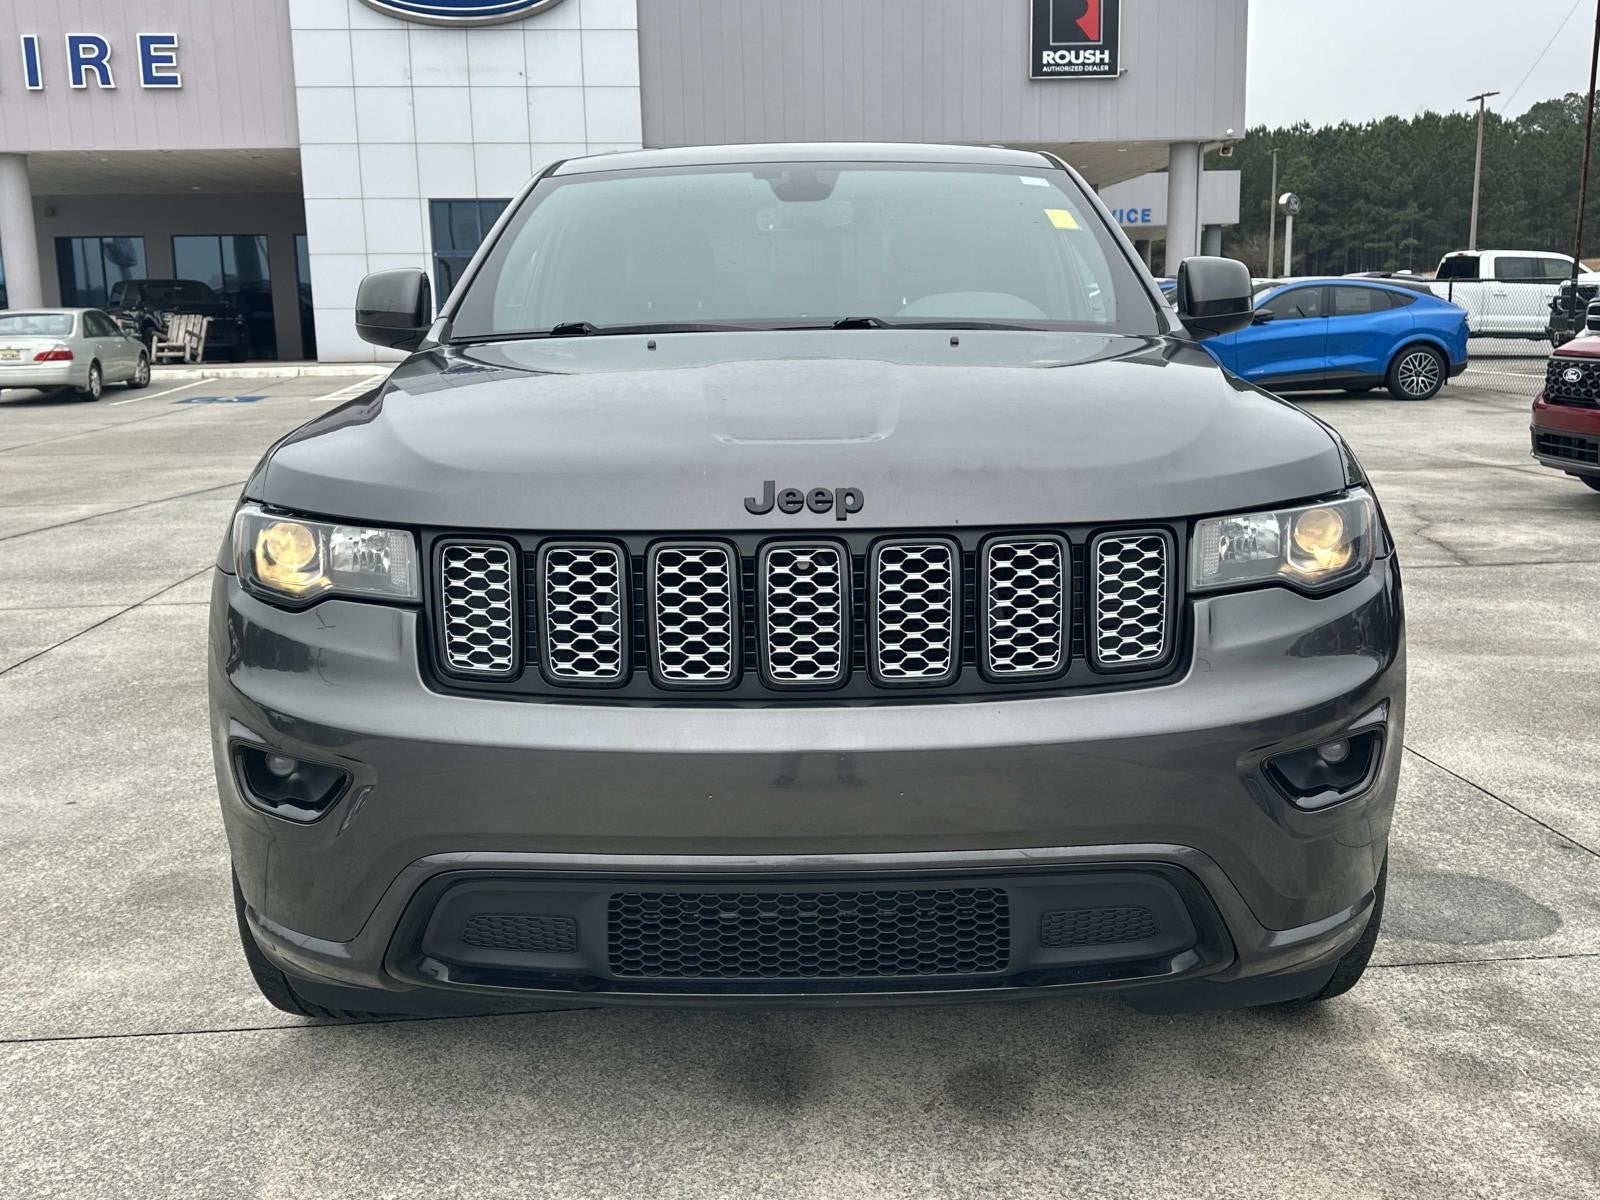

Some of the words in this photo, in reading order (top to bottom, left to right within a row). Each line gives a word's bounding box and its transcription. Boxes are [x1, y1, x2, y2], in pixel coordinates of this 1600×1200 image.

[20, 32, 182, 90] IRE
[1042, 50, 1109, 64] ROUSH
[744, 480, 864, 521] Jeep
